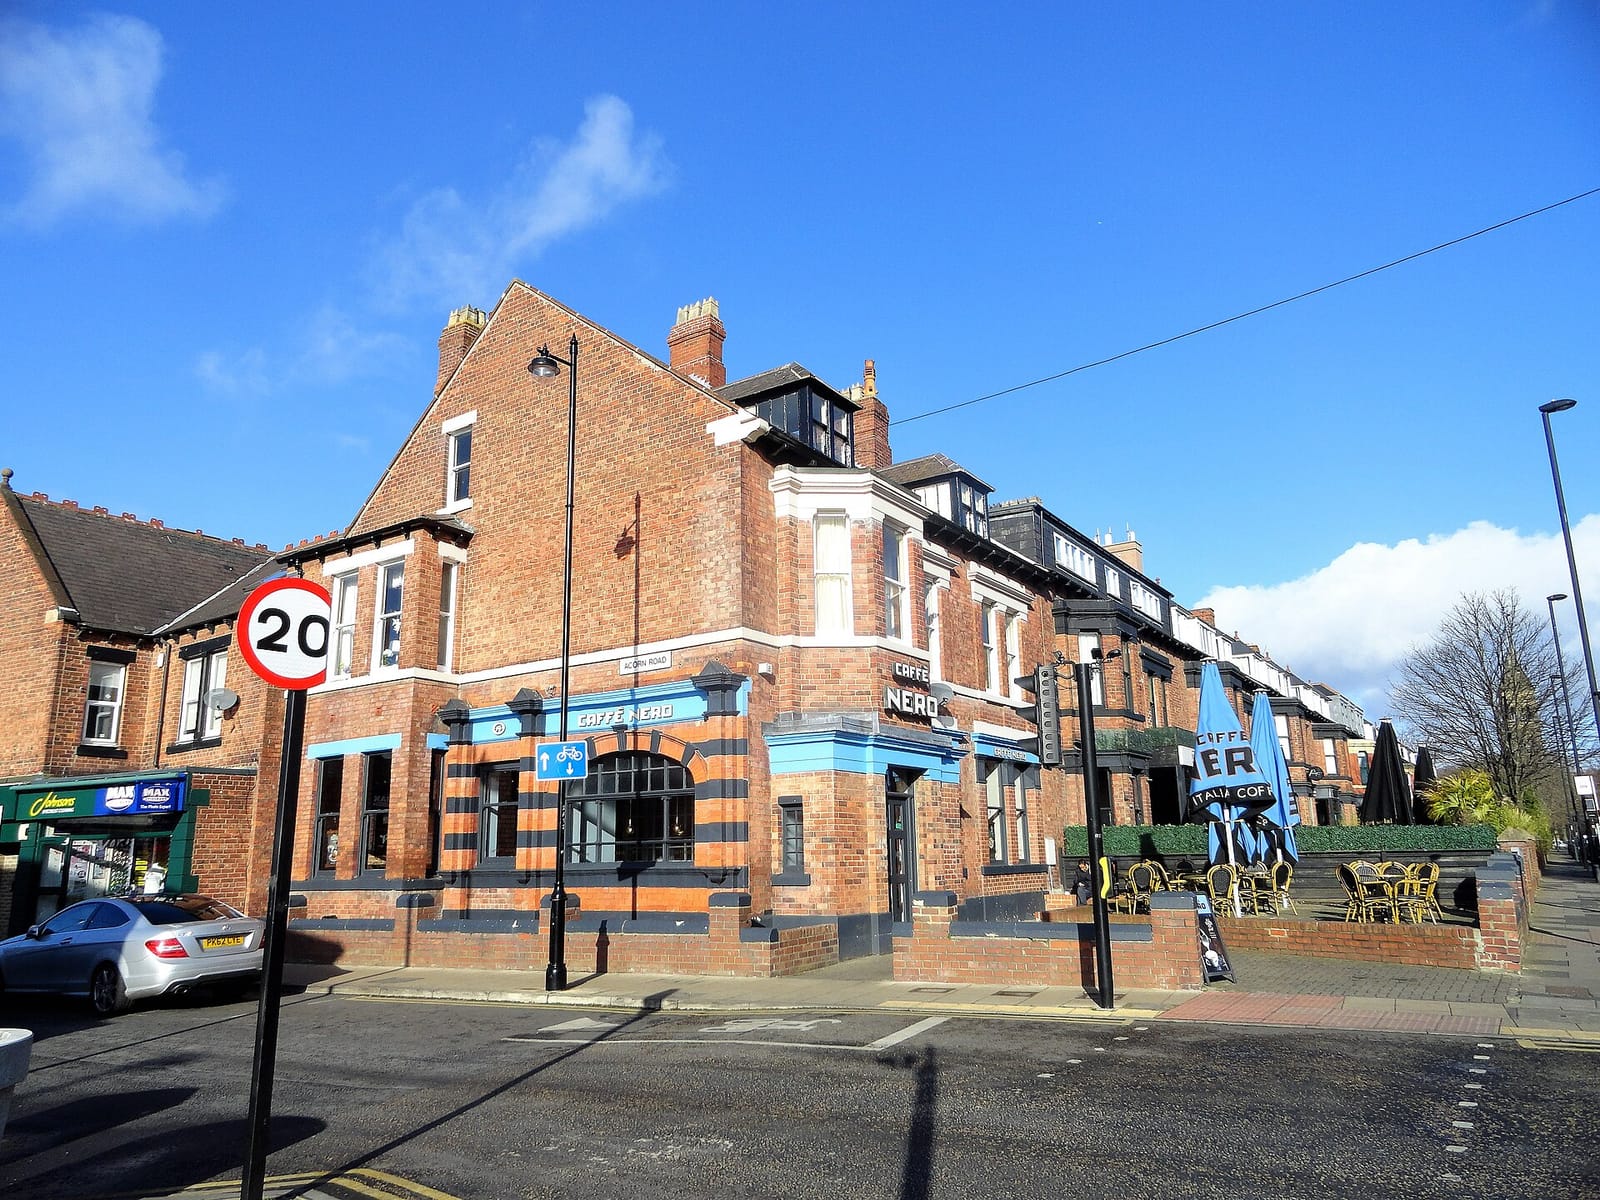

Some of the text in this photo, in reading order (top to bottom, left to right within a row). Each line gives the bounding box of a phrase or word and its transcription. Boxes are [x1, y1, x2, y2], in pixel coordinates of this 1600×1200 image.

[256, 607, 330, 658] 20
[624, 656, 667, 669] ACORN ROAD
[885, 686, 938, 718] NERO
[628, 704, 674, 723] NERO
[106, 785, 136, 799] MAX
[142, 788, 170, 797] MAX
[29, 791, 77, 817] Johnsons
